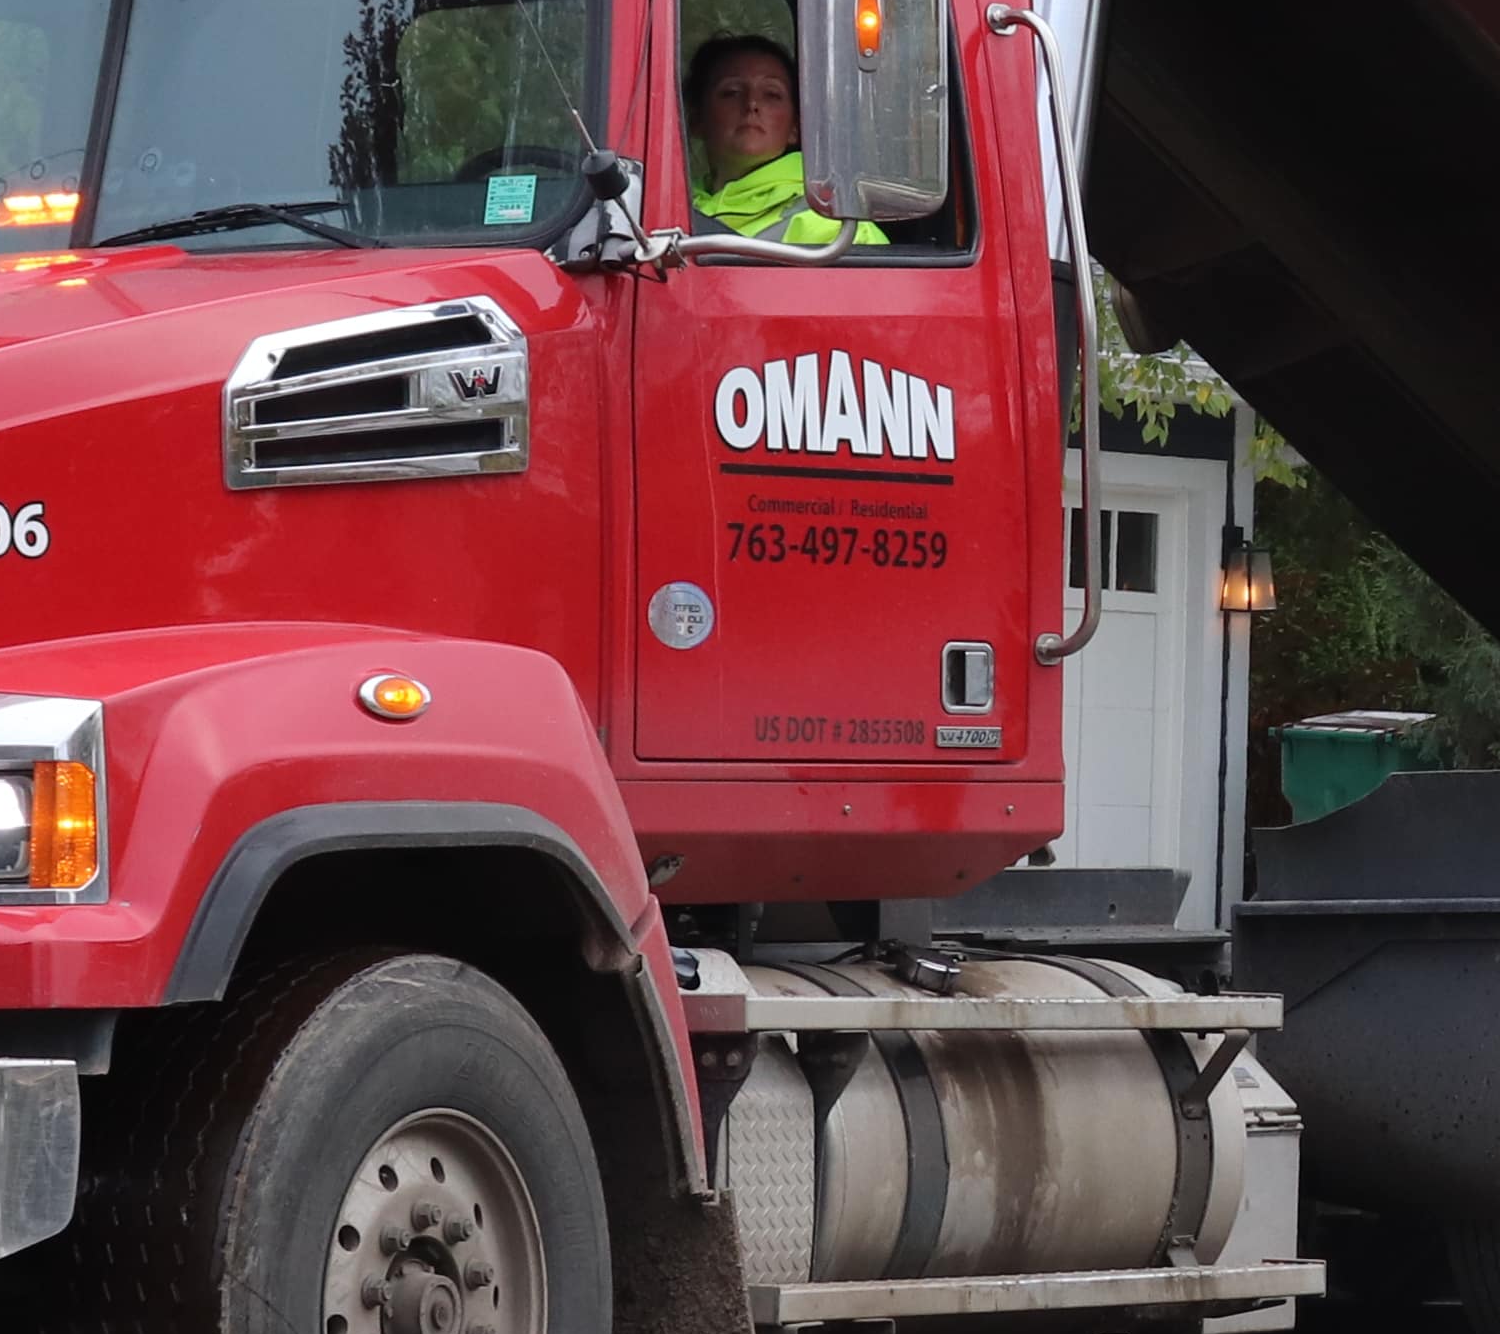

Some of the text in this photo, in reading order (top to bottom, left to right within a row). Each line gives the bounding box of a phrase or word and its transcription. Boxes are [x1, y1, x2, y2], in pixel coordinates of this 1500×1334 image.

[714, 348, 956, 461] OMANN
[748, 494, 835, 516] Commercial
[851, 499, 928, 518] Residential
[727, 522, 948, 569] 763-497-8259
[755, 716, 780, 742] US
[786, 717, 827, 743] DOT
